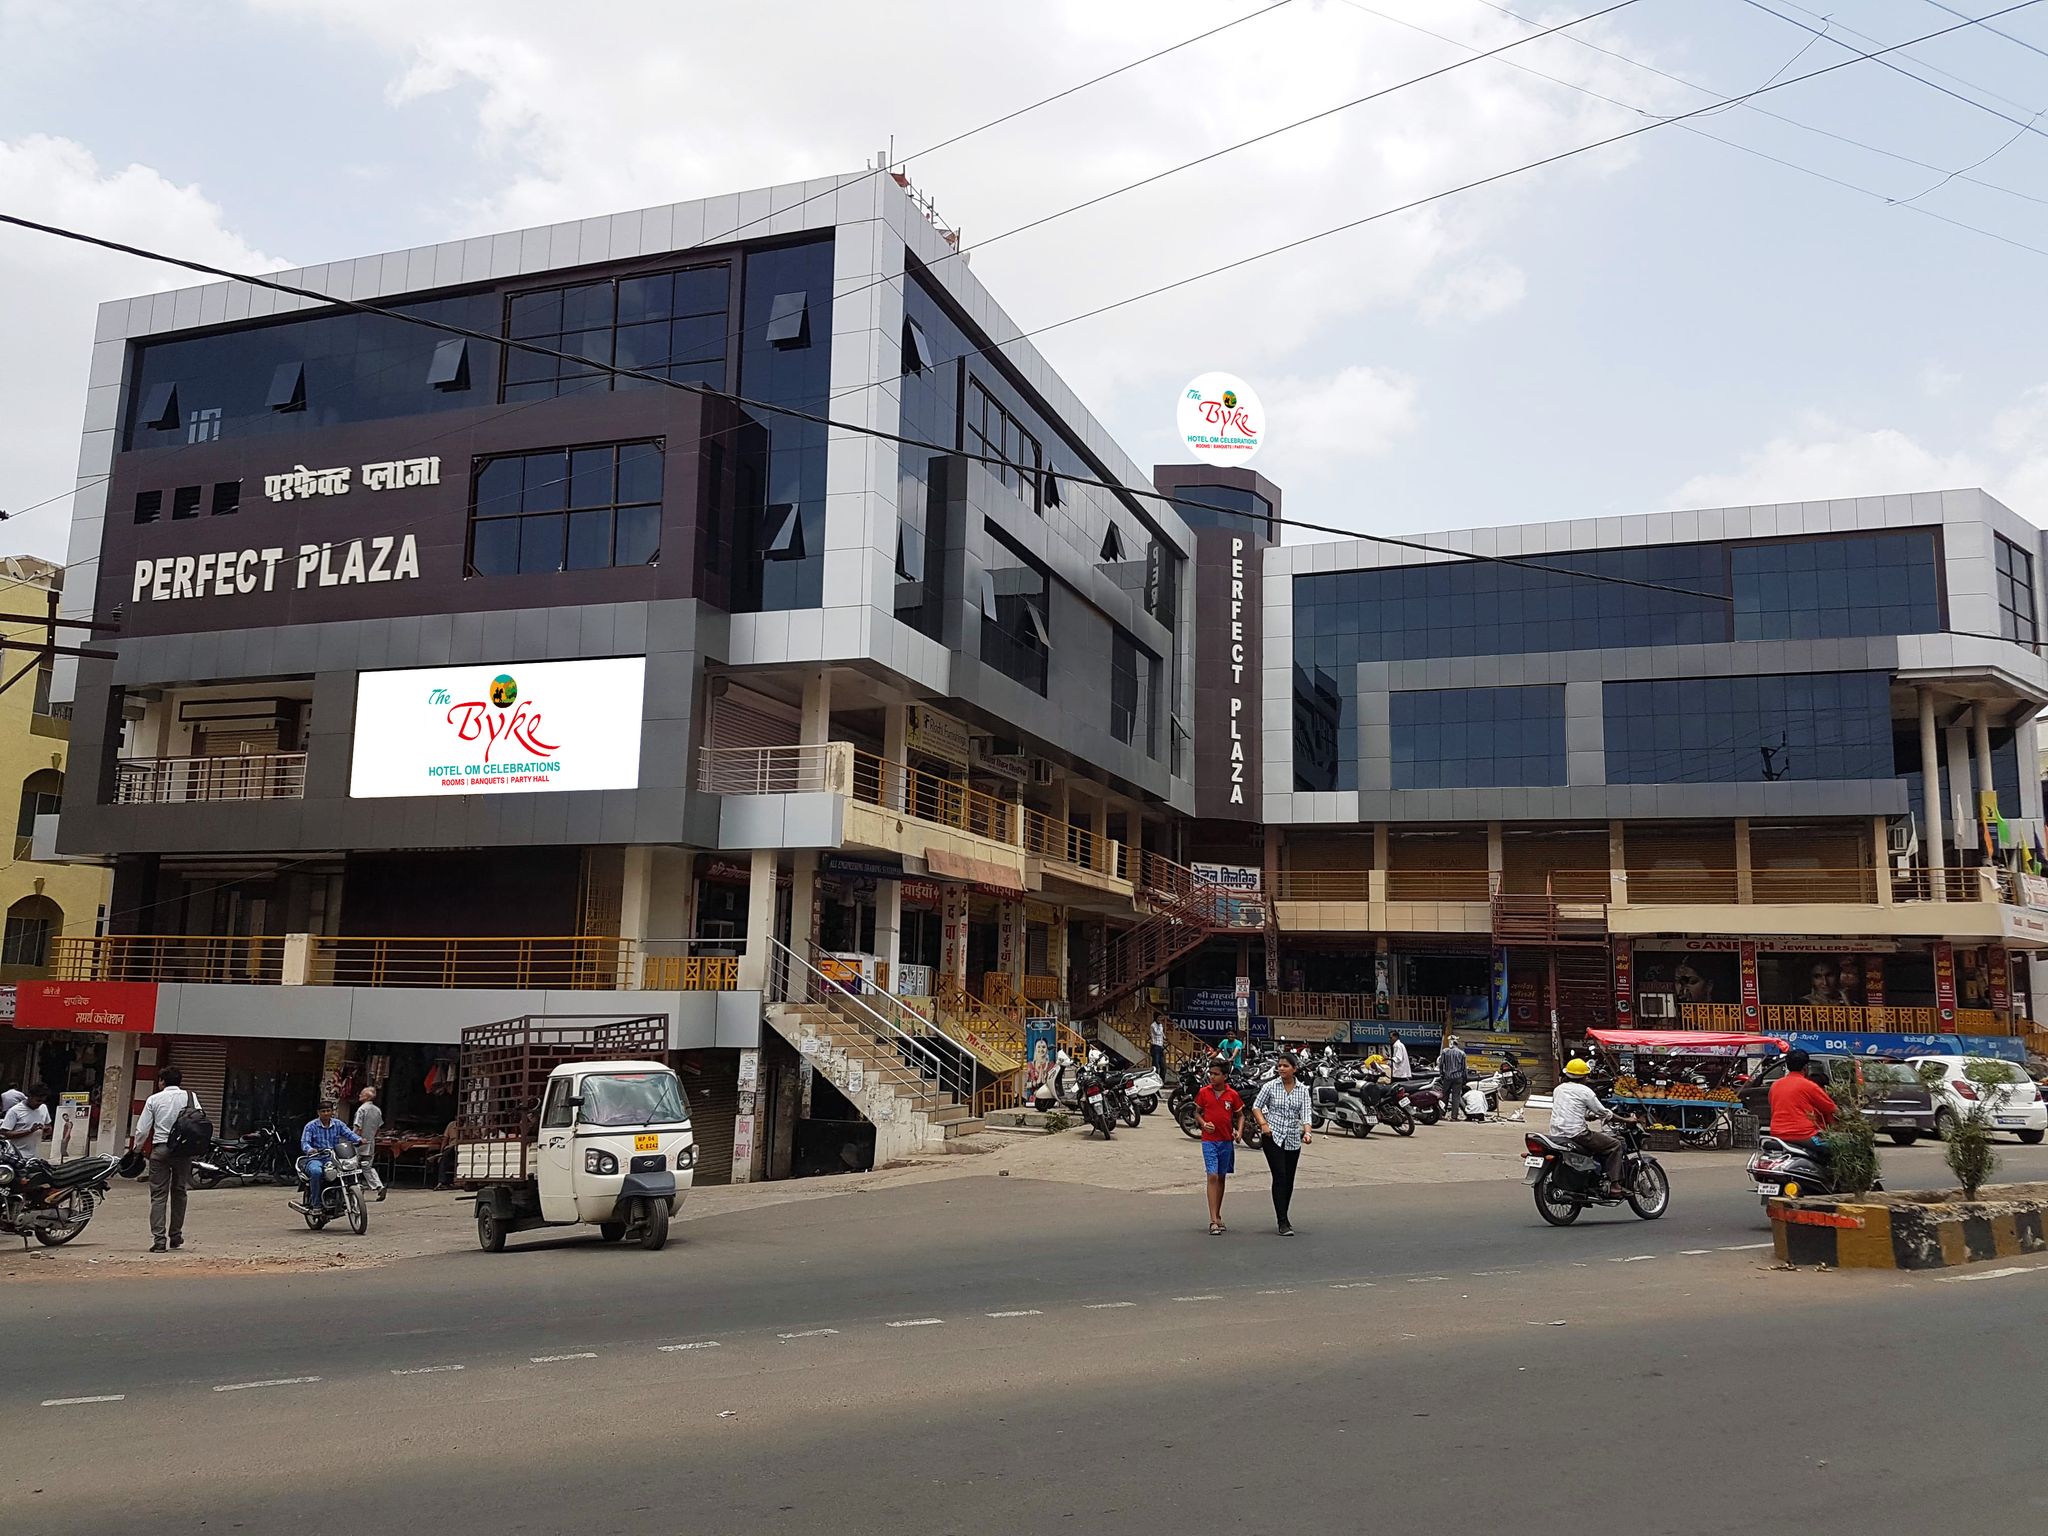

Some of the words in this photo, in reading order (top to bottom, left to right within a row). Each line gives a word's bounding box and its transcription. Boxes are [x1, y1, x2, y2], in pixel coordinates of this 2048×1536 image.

[1186, 389, 1202, 400] The
[1198, 401, 1257, 437] Byke
[1187, 435, 1209, 443] HOTEL
[1219, 437, 1258, 445] CELEBRATIONS
[264, 464, 352, 502] परफेक्ट
[361, 456, 441, 491] प्लाजा
[131, 547, 284, 603] PERFECT
[296, 533, 420, 590] PLAZA
[1231, 537, 1244, 684] PERFECT
[428, 688, 452, 705] The
[446, 700, 561, 763] Byke
[1229, 698, 1244, 805] PLAZA
[428, 766, 462, 777] HOTEL
[464, 764, 481, 775] OM
[483, 761, 561, 774] CELEBRATIONS
[441, 778, 465, 786] ROOMS
[470, 776, 505, 785] BANQUETS
[510, 776, 532, 784] PARTY
[532, 775, 550, 783] HALL
[1686, 940, 1775, 950] GANEH
[1779, 944, 1850, 952] JEWELLERS
[1172, 1017, 1233, 1031] SAMSUNG
